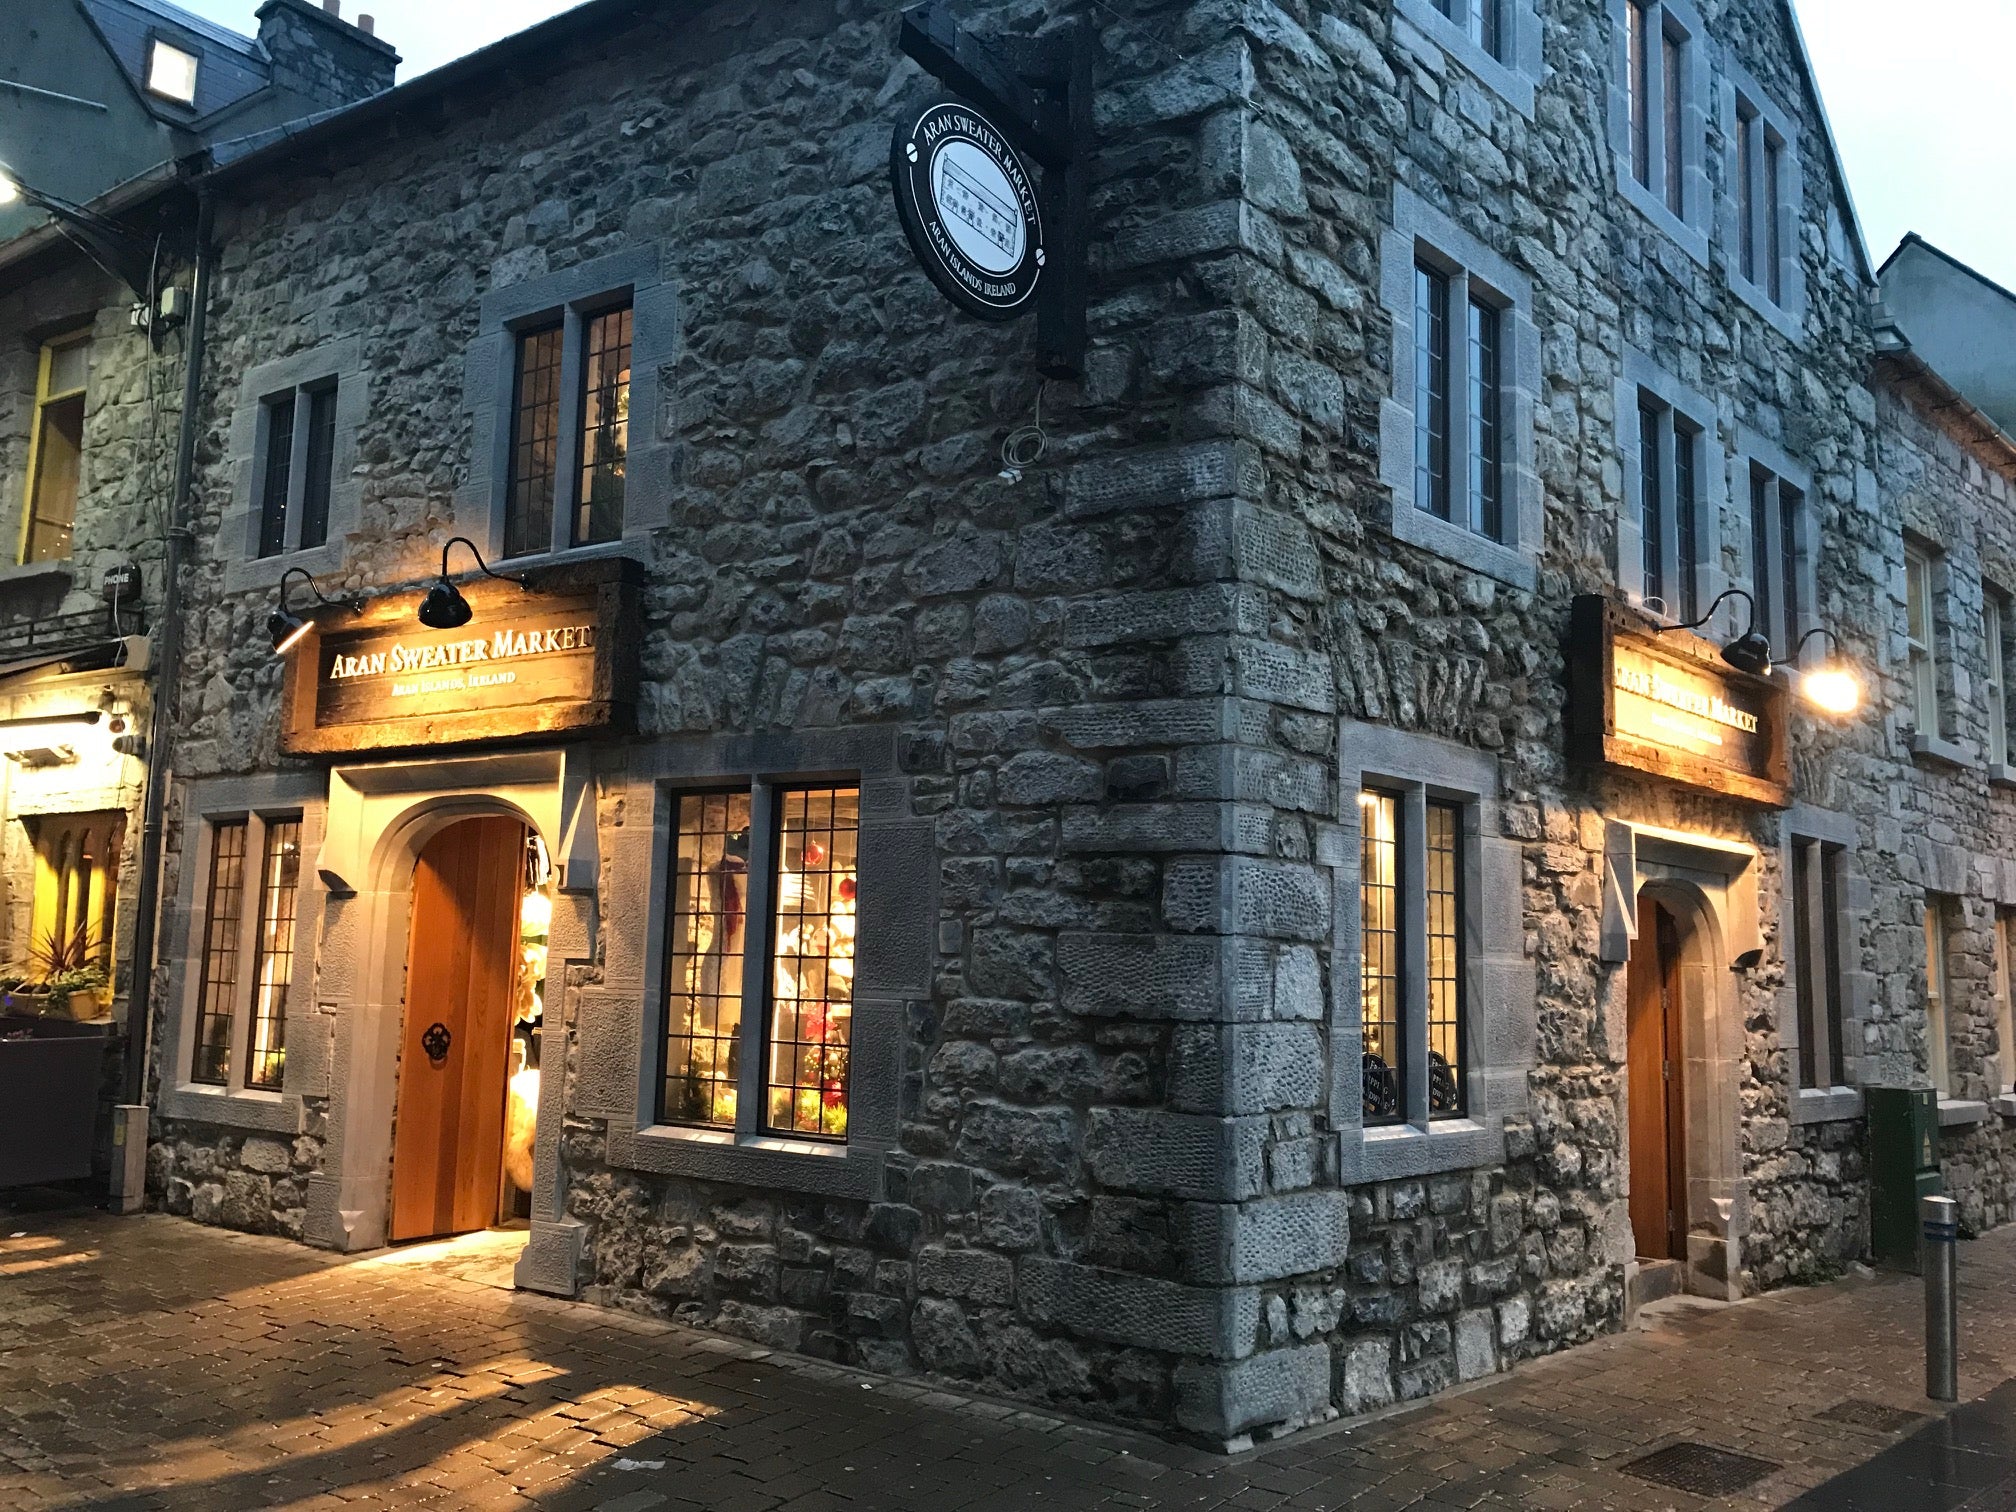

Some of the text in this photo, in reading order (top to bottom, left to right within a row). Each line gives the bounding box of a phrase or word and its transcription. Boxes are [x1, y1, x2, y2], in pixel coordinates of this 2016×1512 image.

[922, 114, 1036, 226] ARAN SWEATER MARKET
[929, 221, 1016, 297] ARAN ISLANDS IRELAND
[104, 573, 129, 586] PHONE
[330, 624, 592, 680] ARAN SWEATER MARKET
[468, 671, 517, 687] IRELAND
[1710, 695, 1758, 733] MARKET
